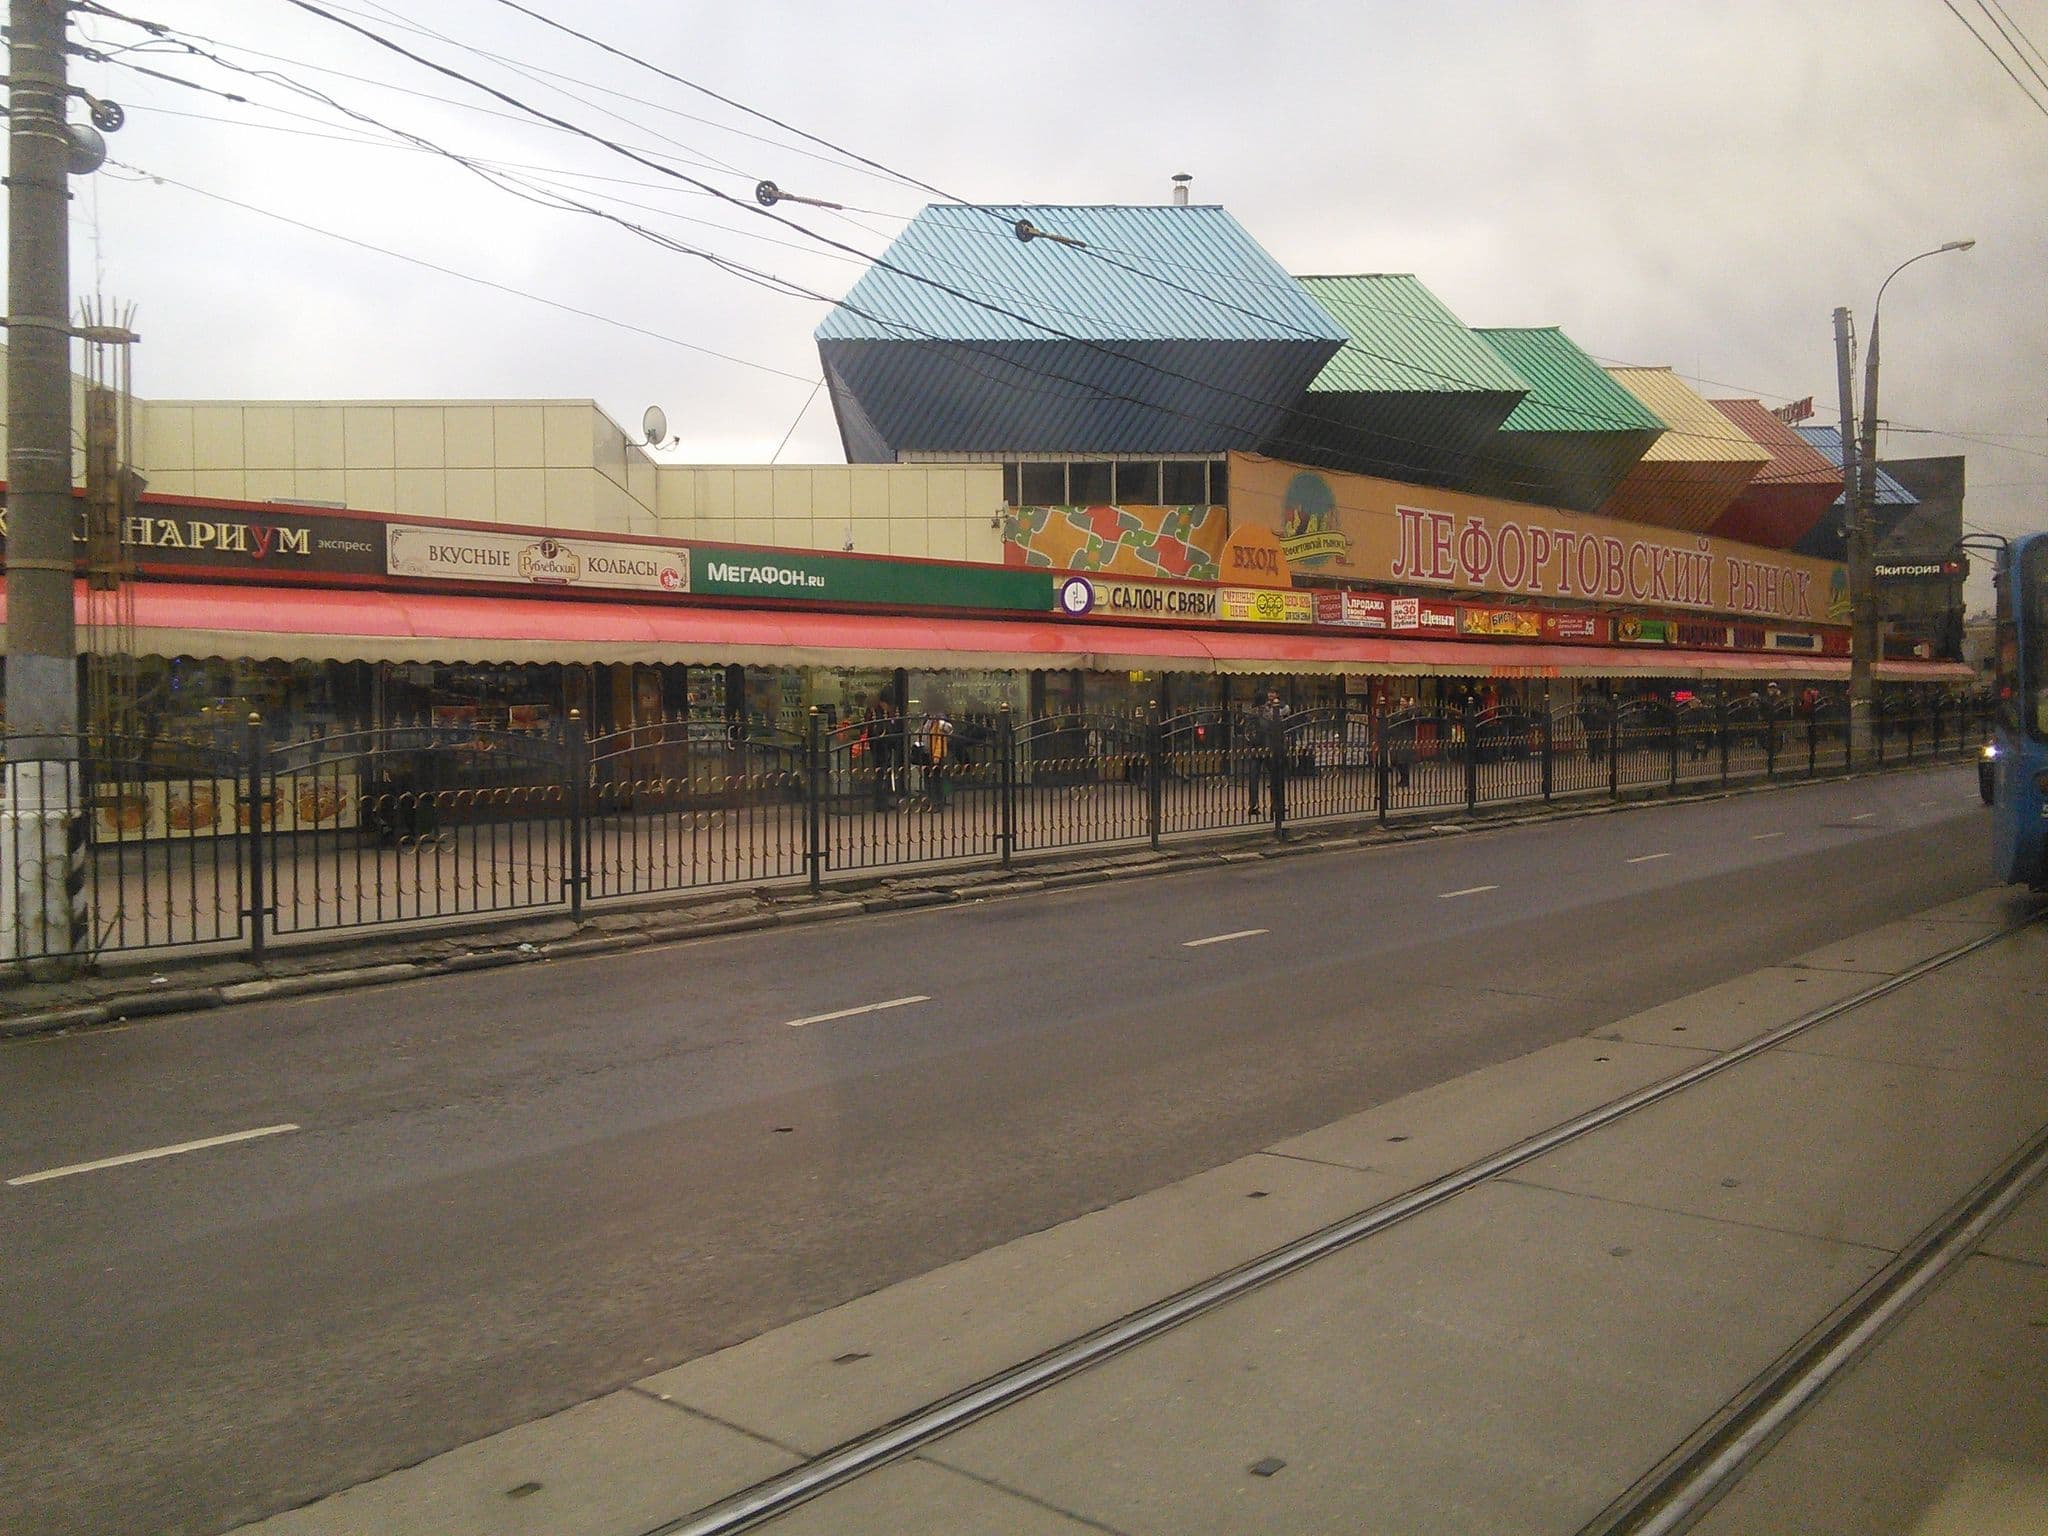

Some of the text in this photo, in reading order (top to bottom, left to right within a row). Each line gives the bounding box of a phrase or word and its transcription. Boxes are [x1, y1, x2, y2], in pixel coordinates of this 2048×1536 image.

[317, 538, 372, 553] экспресс
[429, 545, 658, 577] ВКУСНЫЕ КОЛБАСЫ
[1232, 545, 1279, 576] ВХОД
[1392, 506, 1811, 619] ЛЕФОРТОВСКИЙ РЫНОК
[1875, 565, 1940, 577] Якитория
[1112, 587, 1216, 614] САЛОН СВЯЗИ
[1403, 605, 1416, 615] 30
